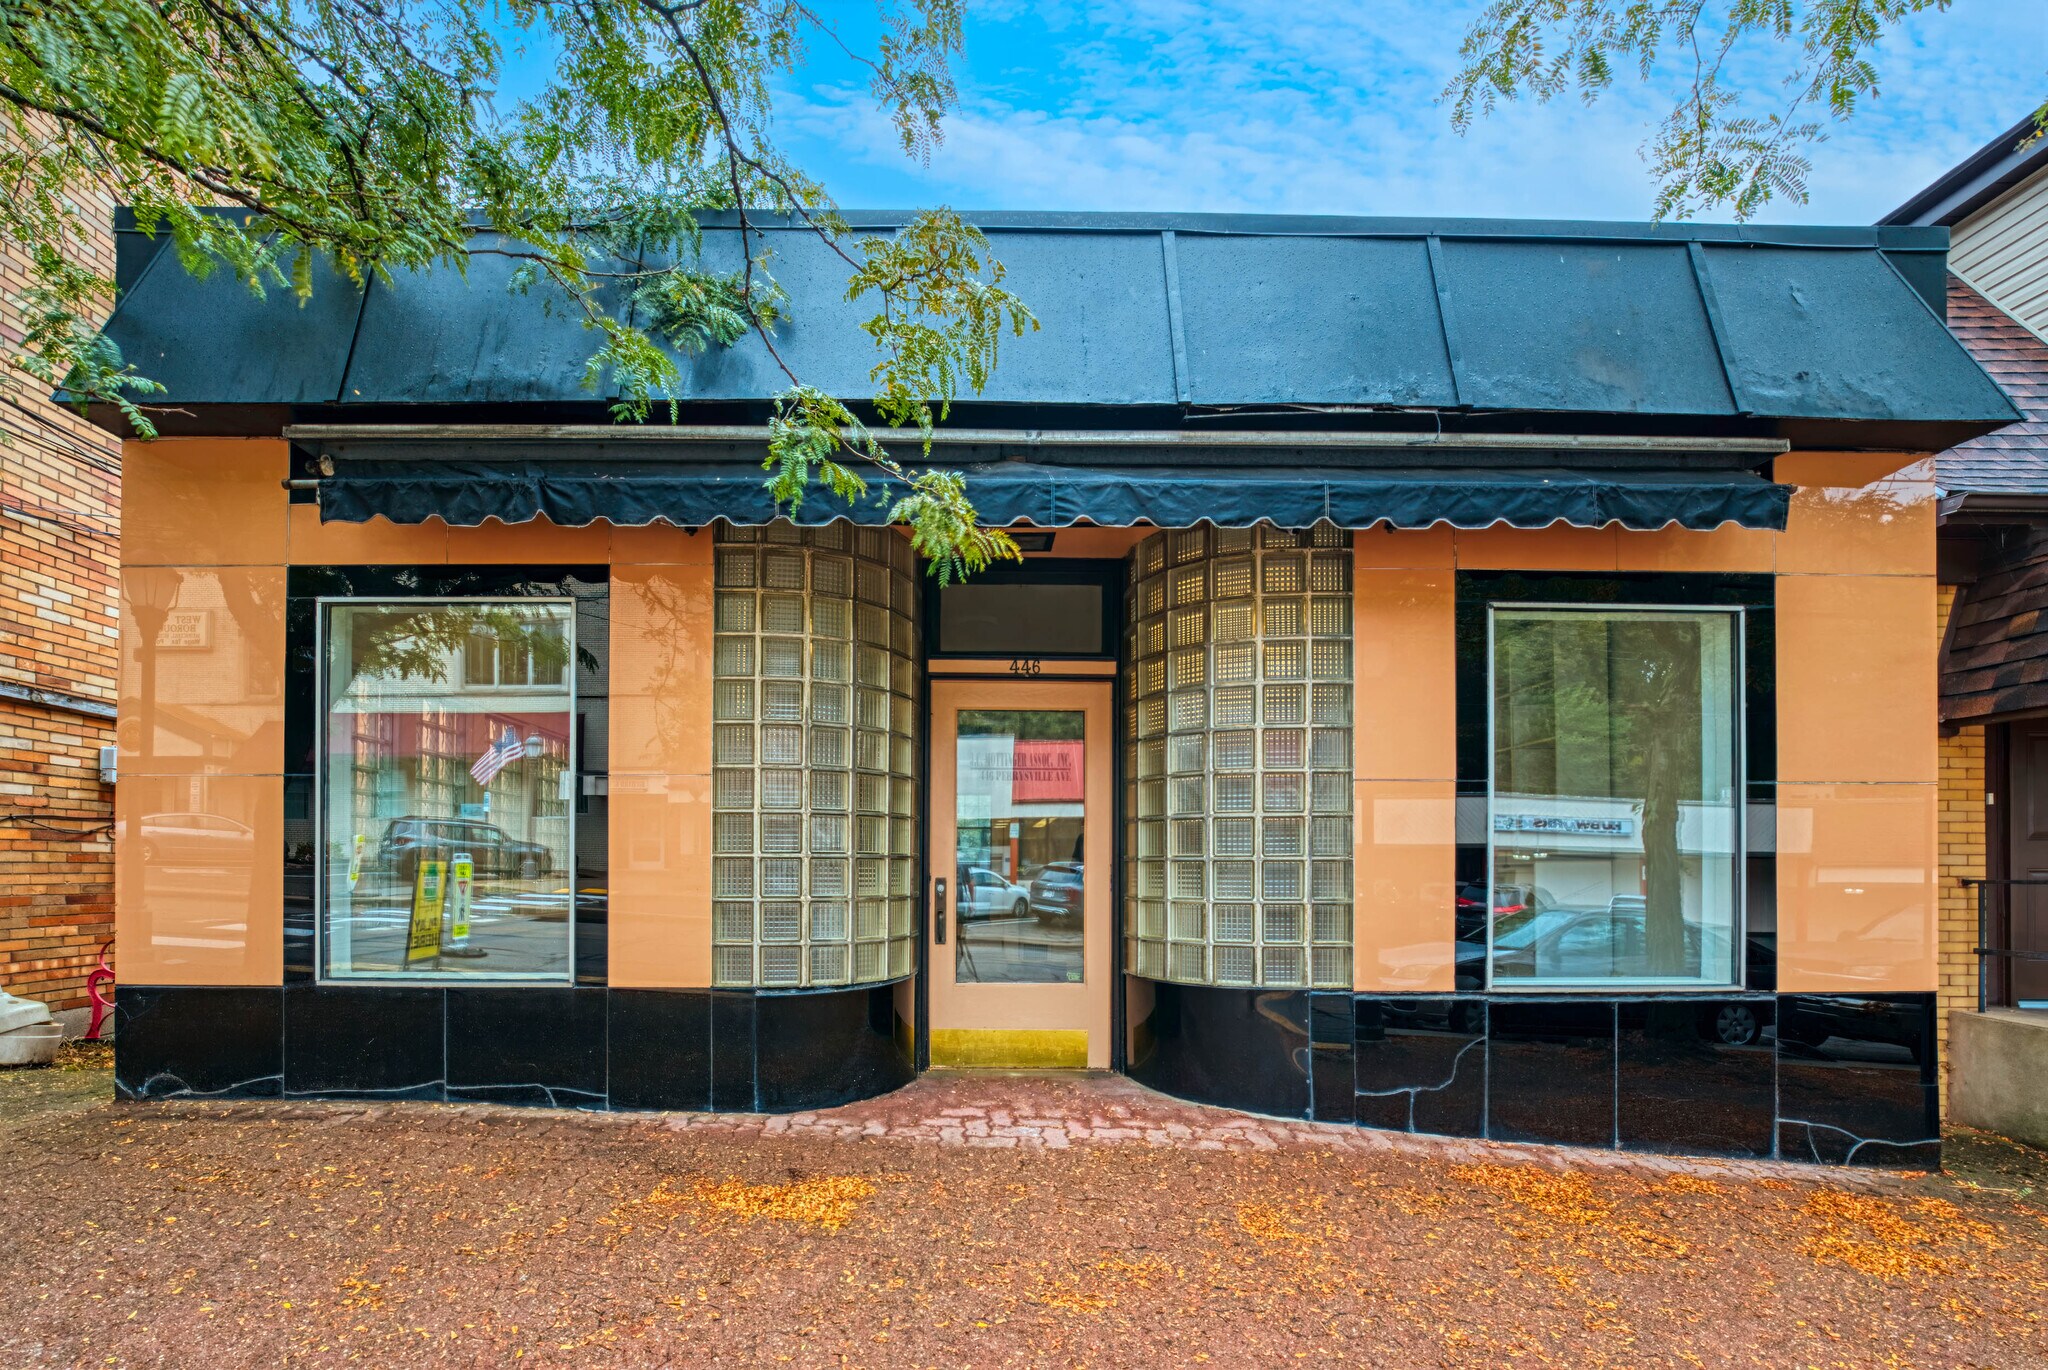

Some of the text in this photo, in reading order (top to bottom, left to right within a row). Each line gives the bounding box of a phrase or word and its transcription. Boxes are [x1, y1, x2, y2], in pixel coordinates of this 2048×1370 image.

[1009, 656, 1041, 675] 446
[1057, 753, 1072, 767] INC.
[996, 771, 1053, 782] PERRYSVILLE
